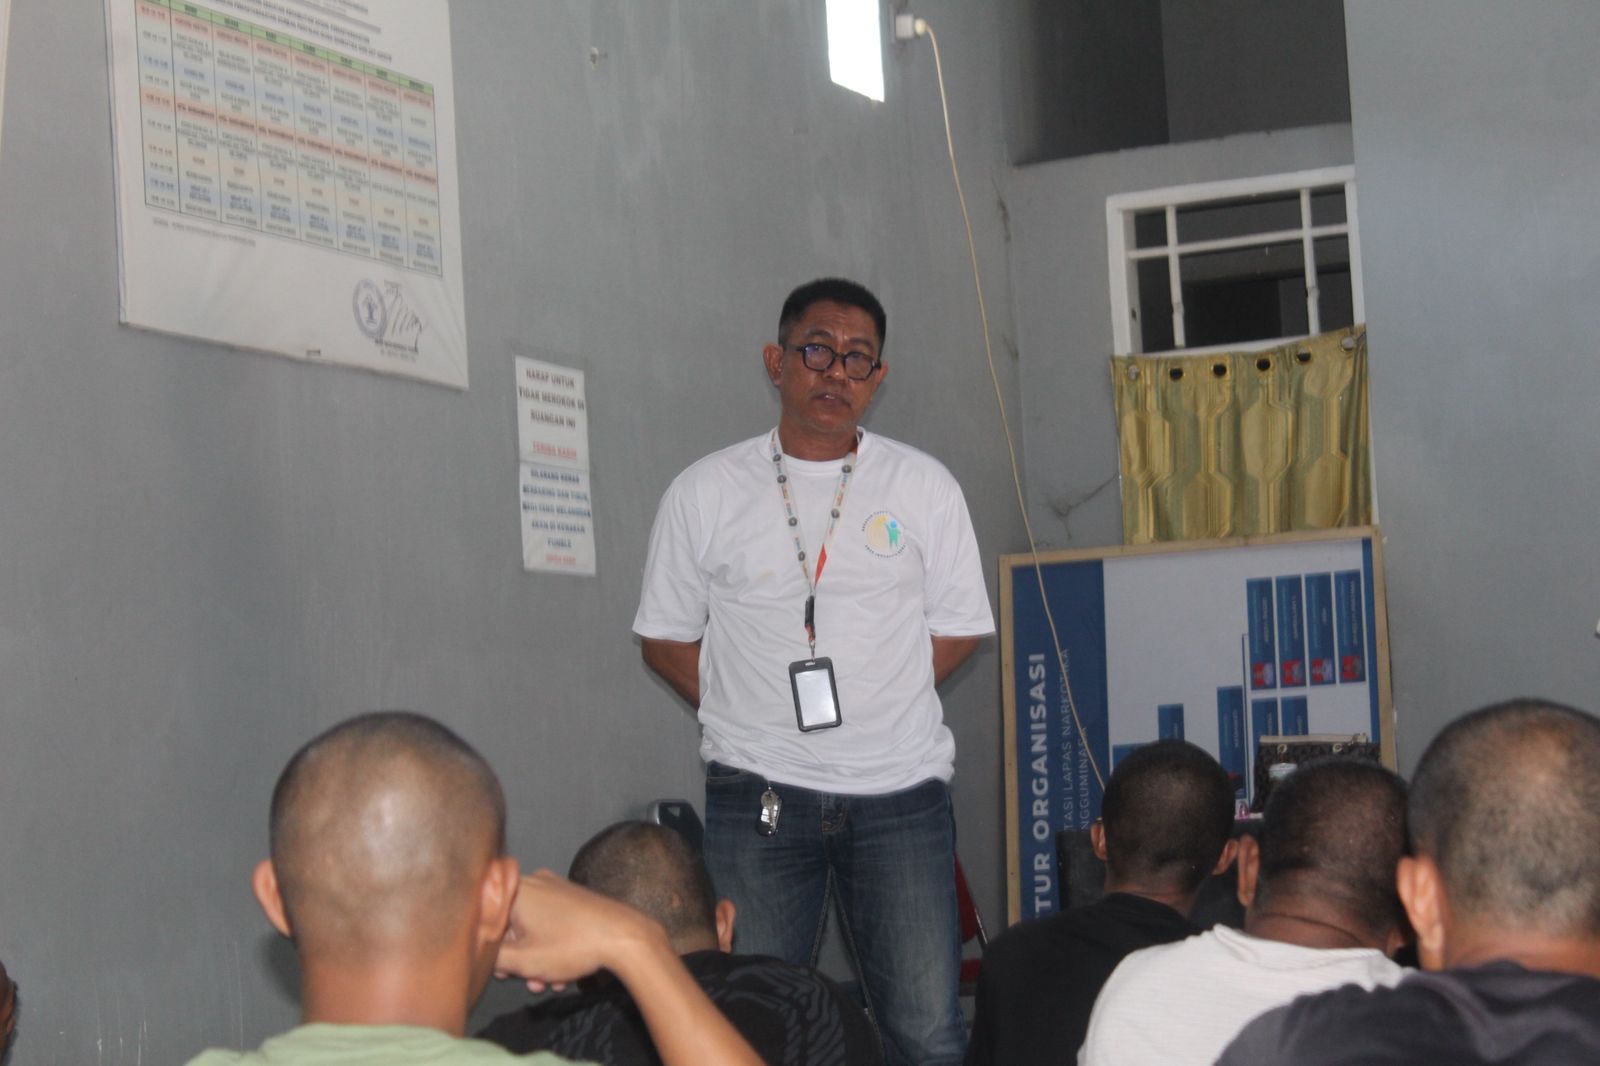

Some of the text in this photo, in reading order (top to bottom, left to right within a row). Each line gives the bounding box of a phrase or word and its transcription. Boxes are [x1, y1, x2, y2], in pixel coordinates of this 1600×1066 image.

[551, 373, 575, 389] UNTUK
[519, 386, 540, 400] TIDAK
[530, 409, 576, 429] RUANGAN INI
[1061, 741, 1074, 791] LAPAS
[1028, 653, 1052, 918] TUR ORGANISASI
